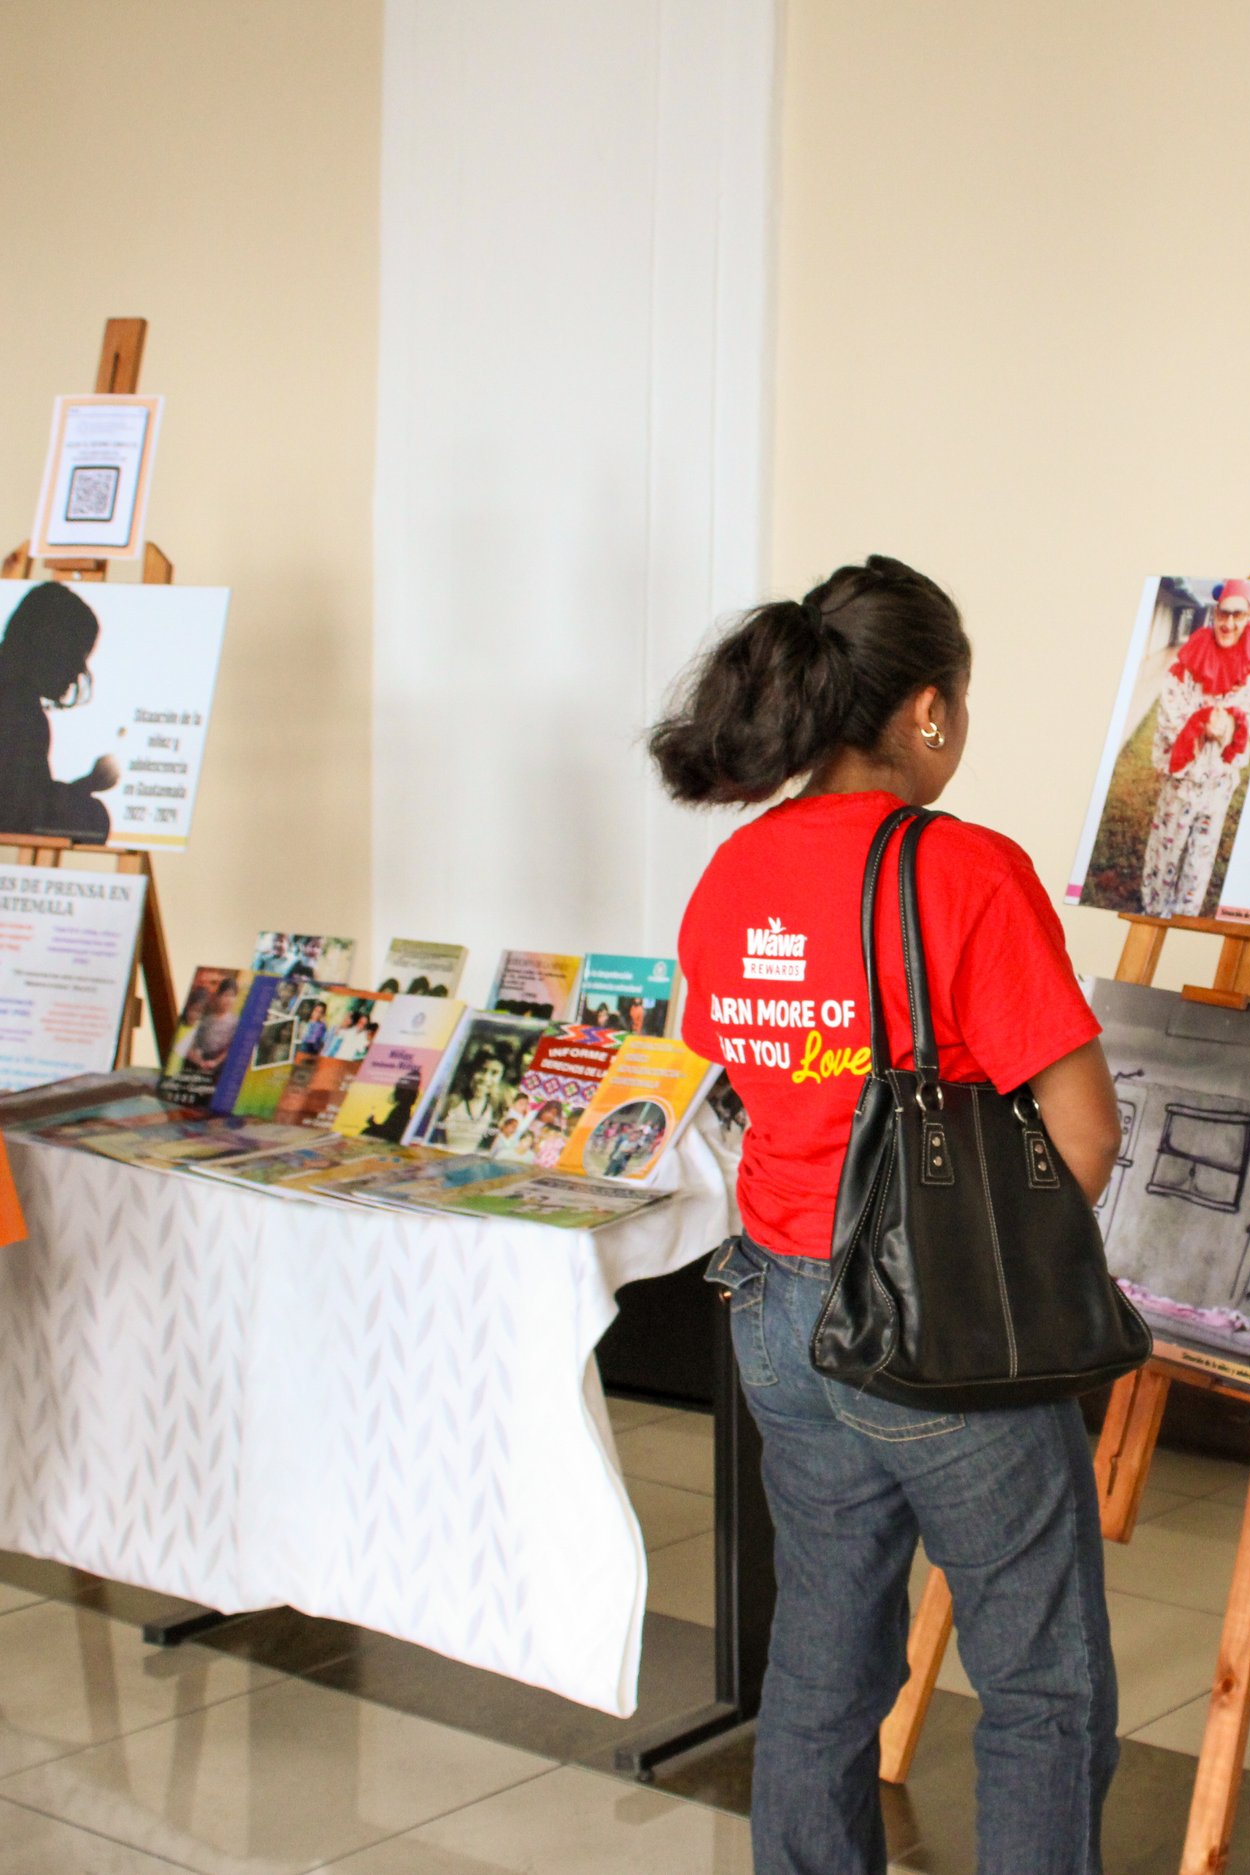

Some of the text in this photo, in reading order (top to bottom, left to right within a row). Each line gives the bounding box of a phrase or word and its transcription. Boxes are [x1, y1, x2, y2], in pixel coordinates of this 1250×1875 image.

[0, 876, 16, 890] ES
[19, 878, 41, 893] DE
[45, 880, 104, 898] PRENSA
[0, 896, 74, 916] ATEMALA
[747, 928, 807, 957] Wawa
[751, 963, 800, 976] REWARDS
[757, 999, 815, 1028] MORE
[821, 1000, 855, 1028] OF
[548, 1047, 608, 1062] INFORME
[718, 1030, 872, 1084] AT YOU Love
